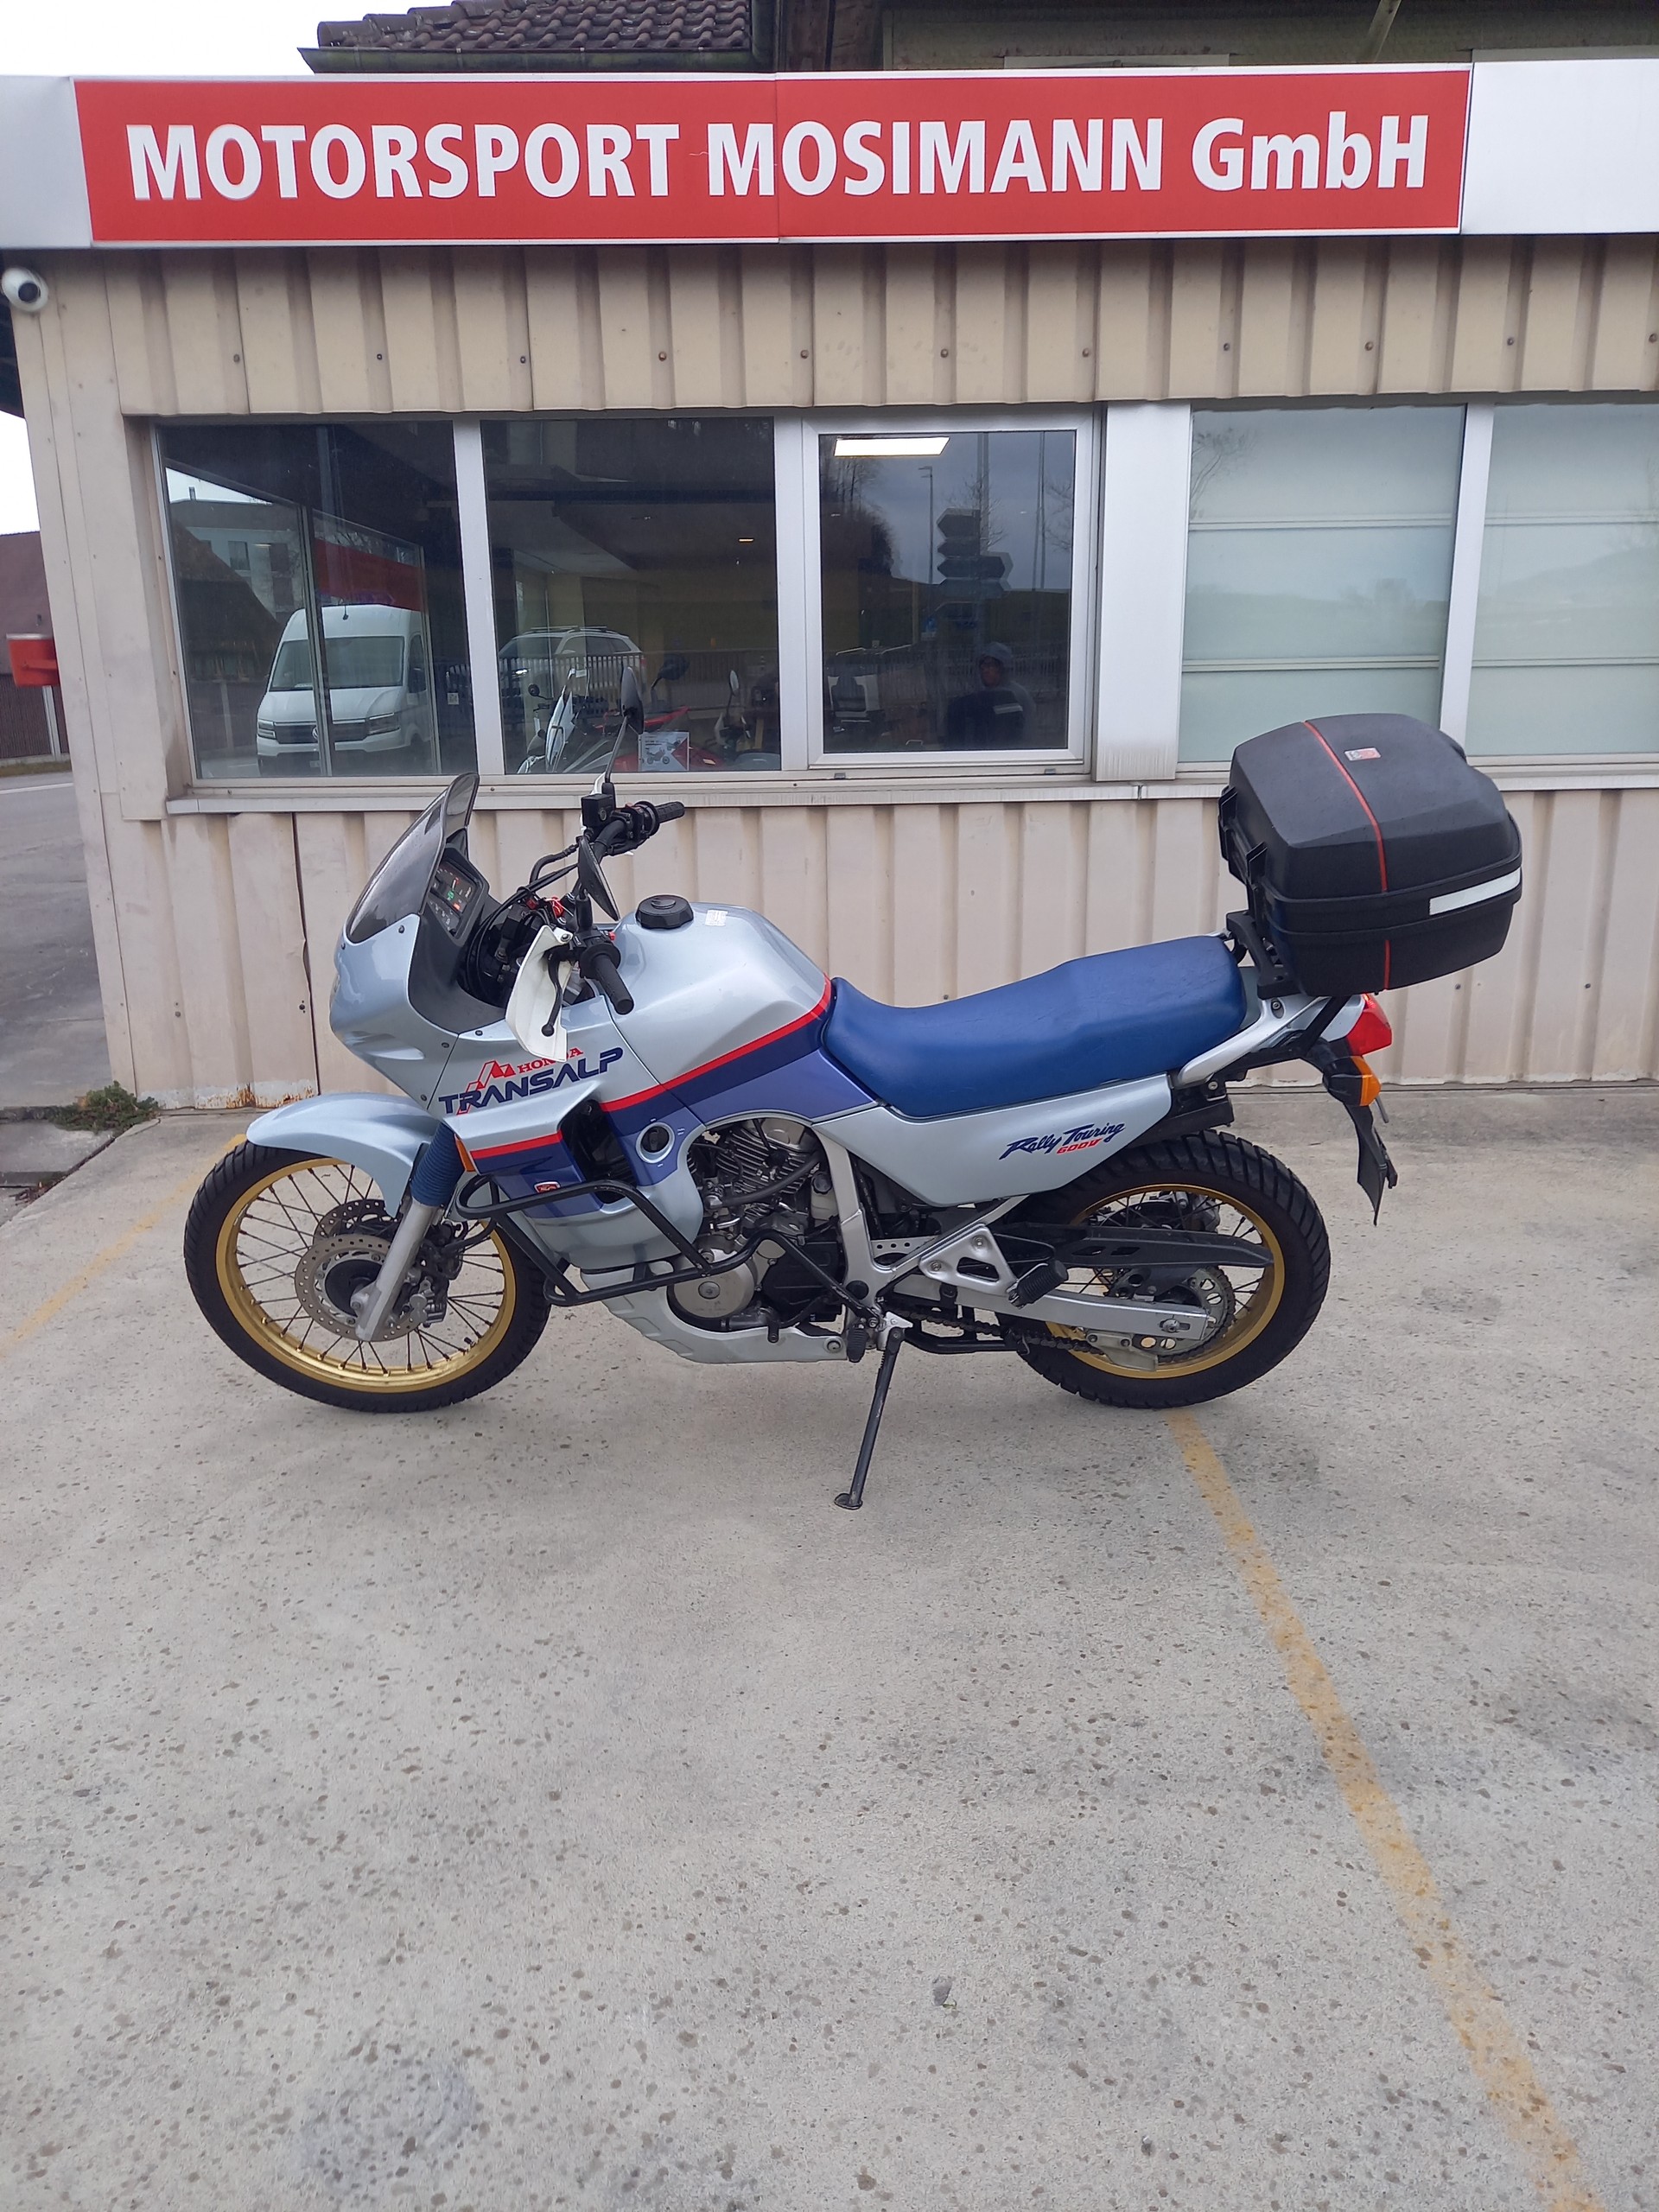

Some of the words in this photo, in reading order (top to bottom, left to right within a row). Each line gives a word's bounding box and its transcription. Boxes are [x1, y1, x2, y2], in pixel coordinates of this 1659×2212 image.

[126, 123, 680, 200] MOTORSPORT
[707, 118, 1163, 196] MOSIMANN
[1192, 111, 1430, 190] GmbH
[517, 1047, 584, 1074] HONA
[438, 1046, 624, 1115] TRANSALP
[999, 1133, 1063, 1160] Rally
[1063, 1122, 1127, 1147] Touring
[1056, 1137, 1103, 1155] 600V
